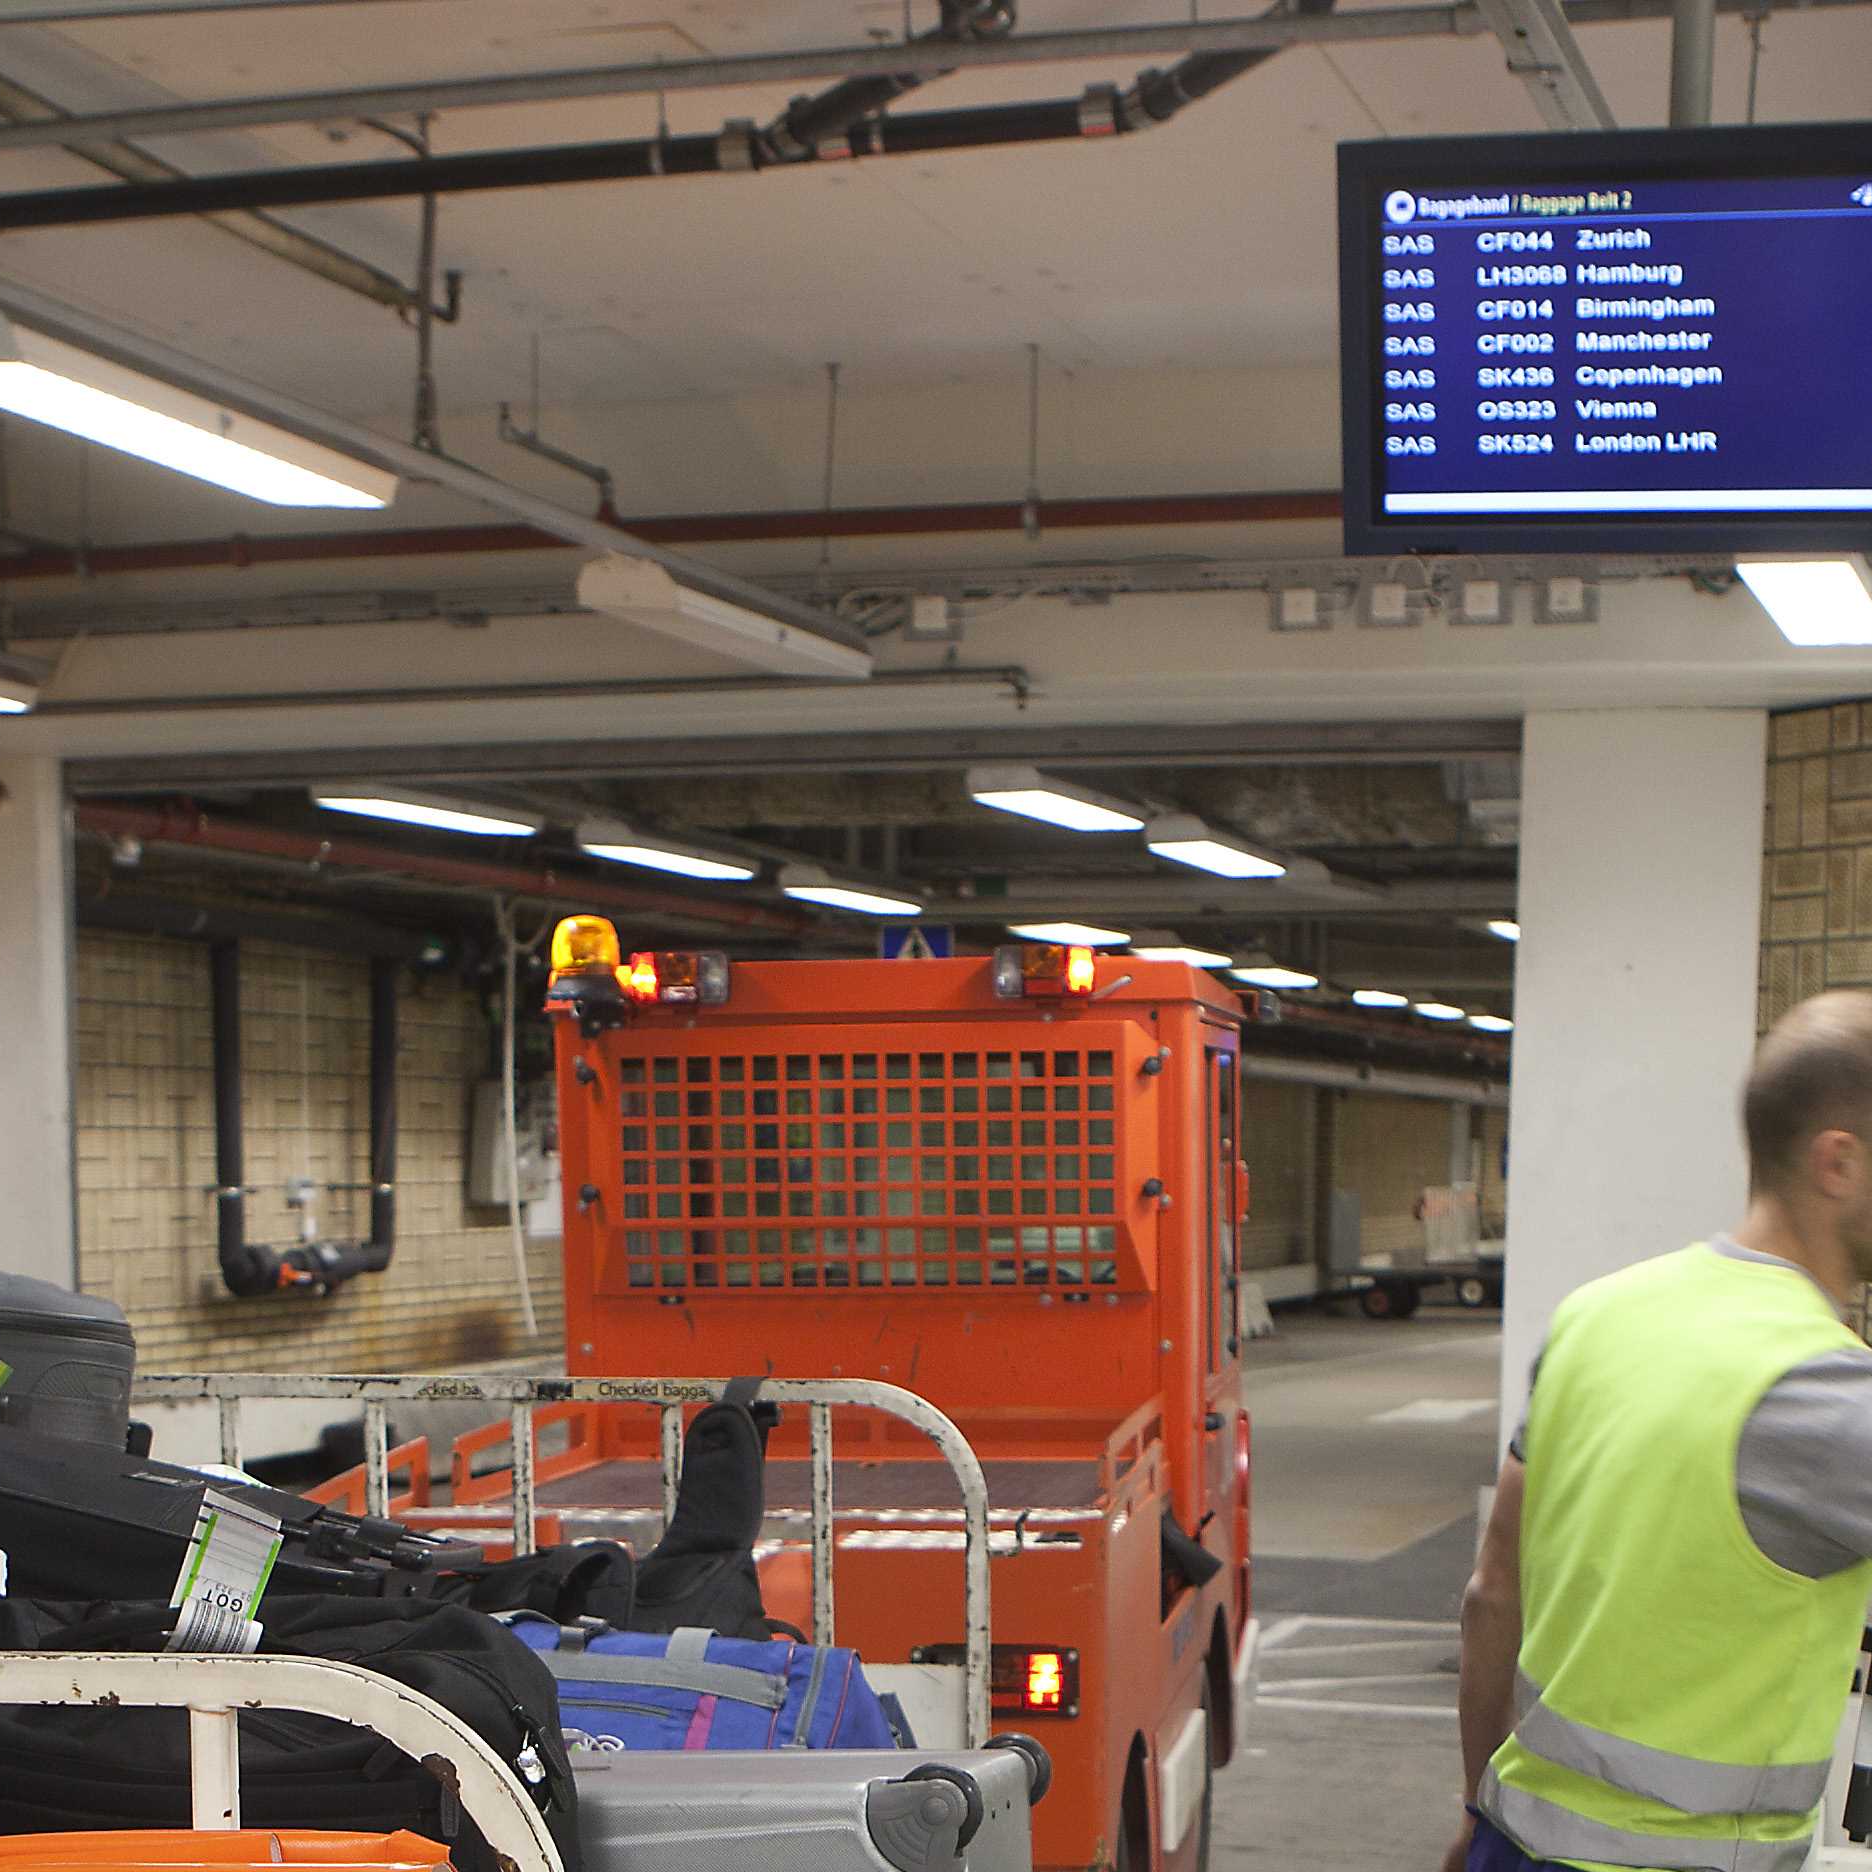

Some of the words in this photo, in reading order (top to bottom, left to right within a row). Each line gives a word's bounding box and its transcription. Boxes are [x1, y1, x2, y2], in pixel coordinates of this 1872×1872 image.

[1418, 194, 1510, 220] Bagageband
[1519, 193, 1585, 216] Baggage
[1587, 190, 1619, 212] Belt
[1621, 189, 1632, 211] 2
[1383, 234, 1434, 256] SAS
[1477, 231, 1554, 253] CF044
[1577, 228, 1651, 250] Zurich
[1383, 268, 1435, 288] SAS
[1576, 262, 1683, 285] Hamburg
[1384, 303, 1435, 322] SAS
[1477, 299, 1554, 320] CF014
[1576, 296, 1715, 319] Birmingham
[1384, 336, 1435, 356] SAS
[1478, 333, 1555, 354] CF002
[1576, 330, 1713, 352] Manchester
[1385, 369, 1436, 389] SAS
[1575, 364, 1723, 387] Copenhagen
[1385, 402, 1436, 423] SAS
[1478, 400, 1556, 421] OS323
[1574, 400, 1658, 420] Vienna
[1385, 435, 1437, 456] SAS
[1478, 434, 1554, 454] SK524
[1575, 432, 1661, 453] London
[1665, 431, 1717, 452] LHR
[598, 1381, 659, 1398] Checked
[663, 1382, 714, 1401] bagga
[200, 1588, 244, 1613] GOT
